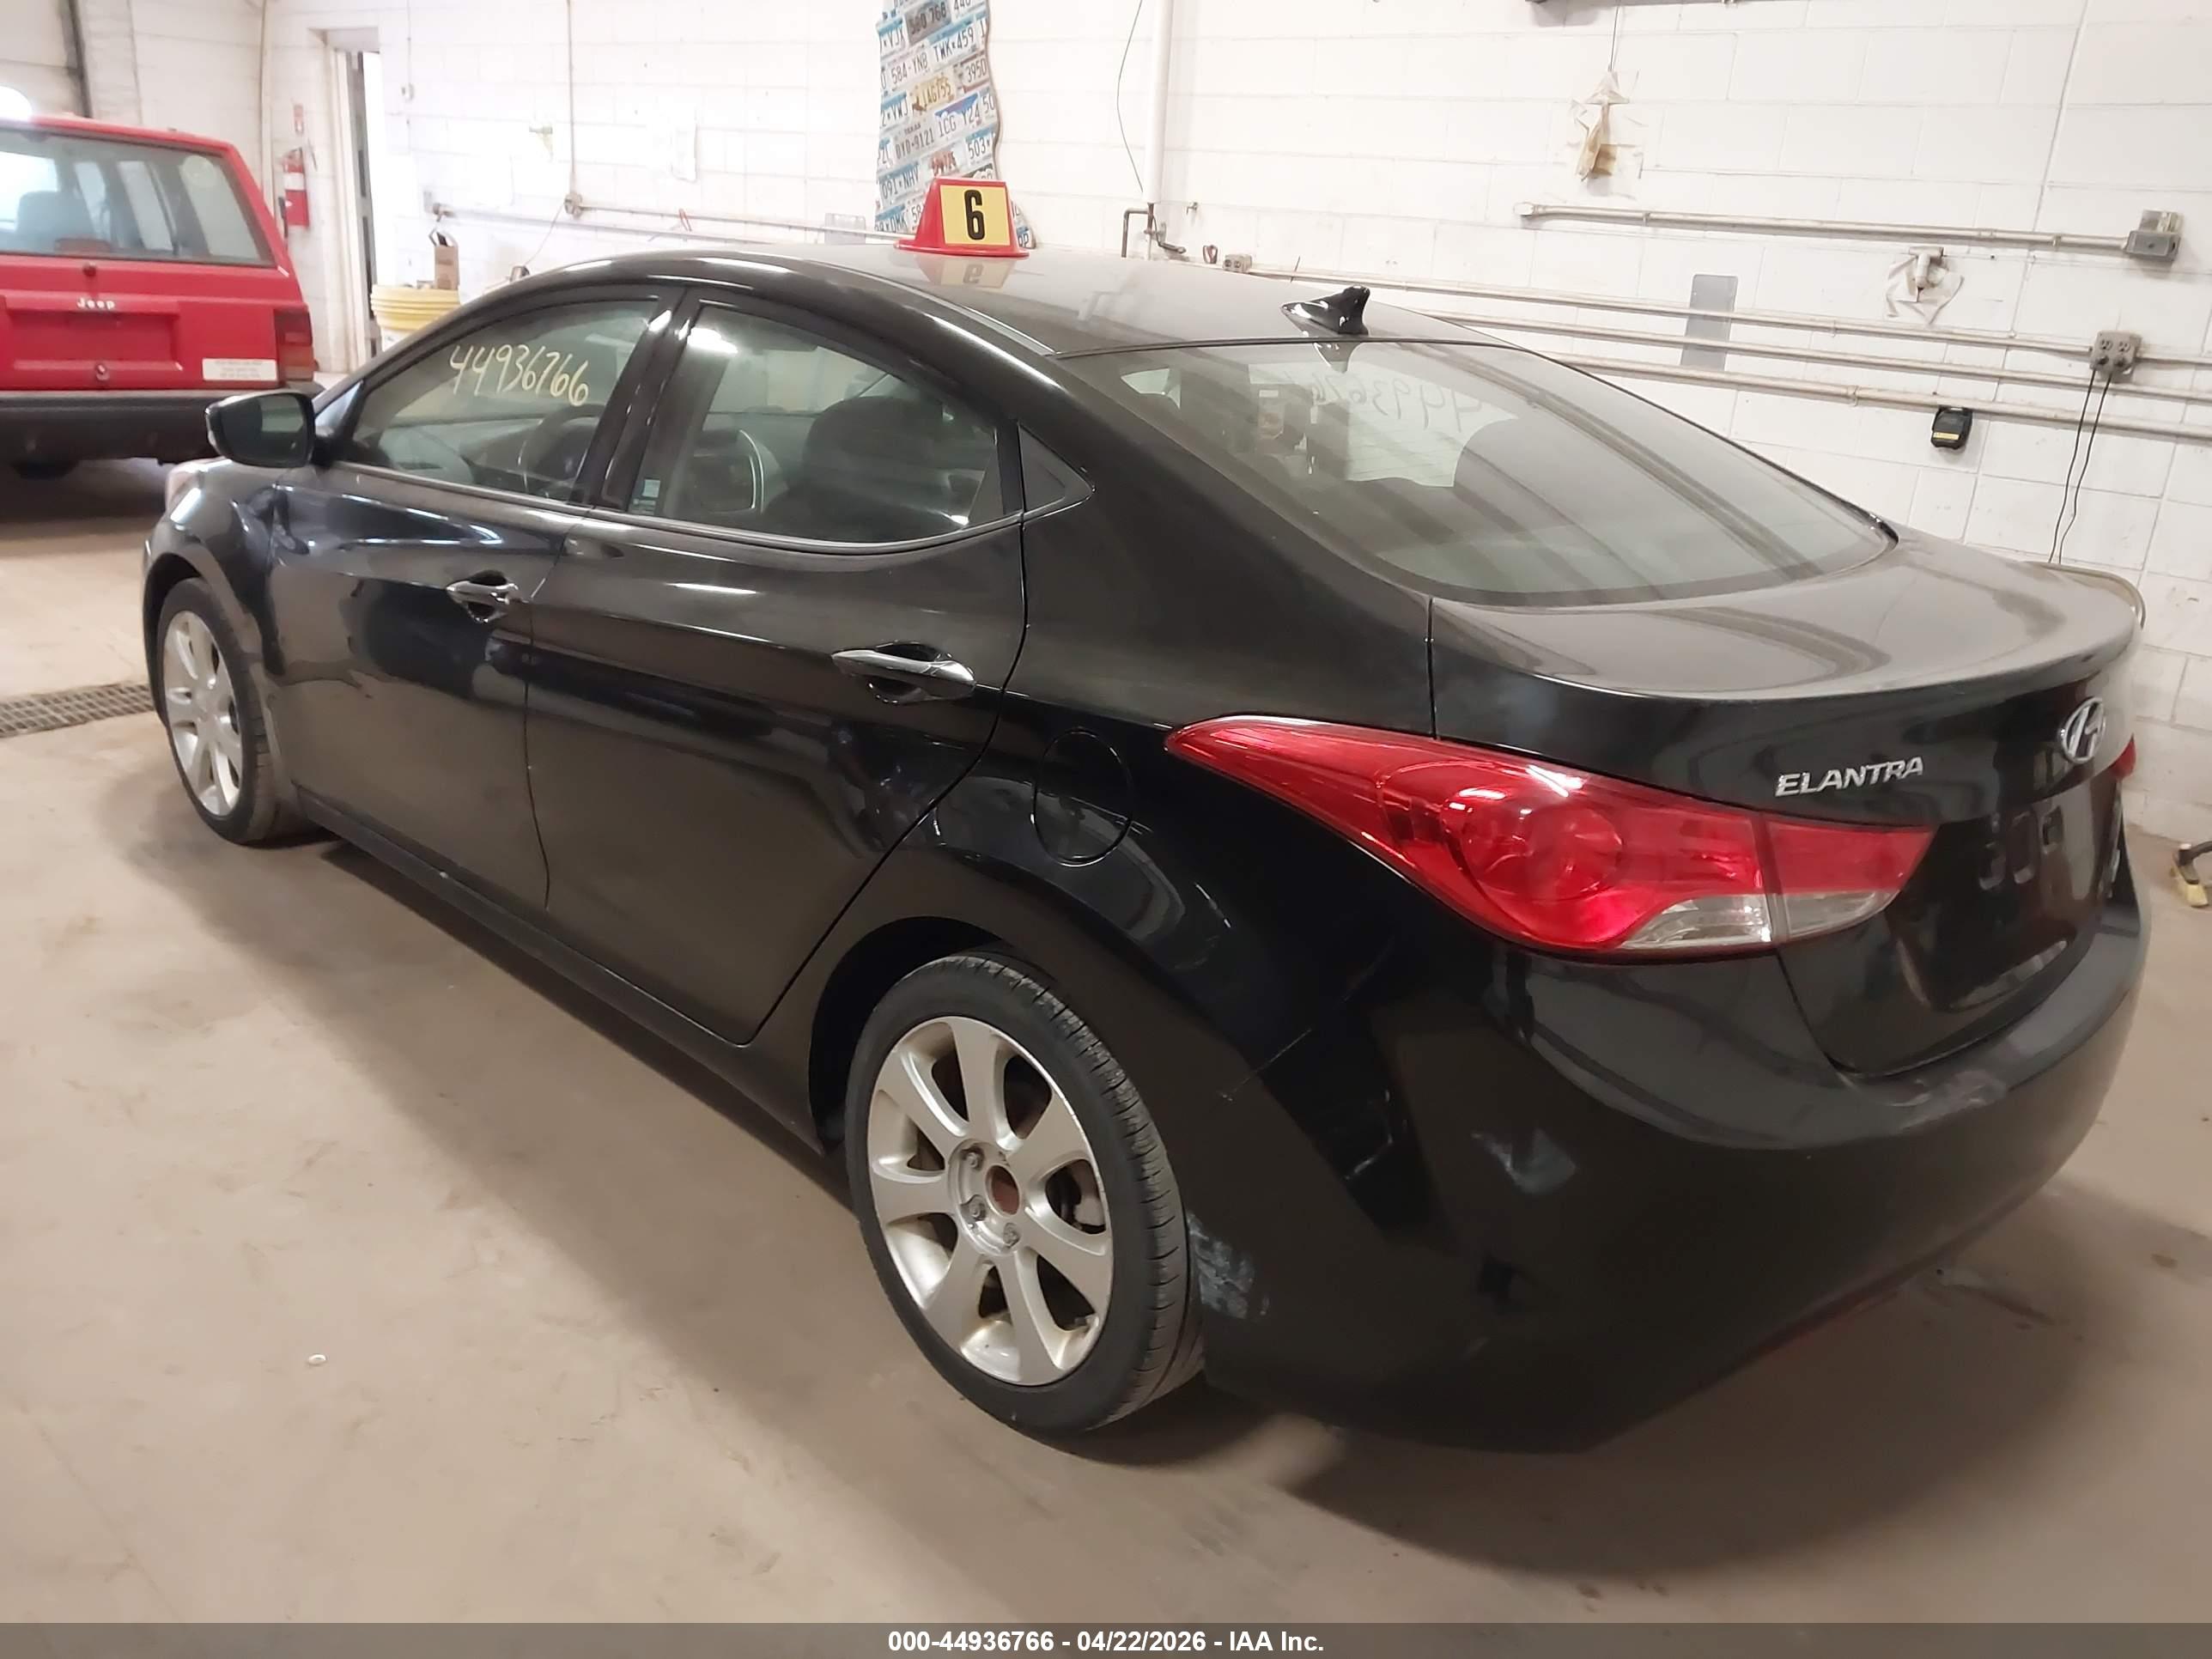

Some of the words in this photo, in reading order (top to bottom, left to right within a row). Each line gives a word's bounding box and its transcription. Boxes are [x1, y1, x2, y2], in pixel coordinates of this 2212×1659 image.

[963, 190, 986, 240] 6
[76, 297, 116, 310] Jeep
[449, 343, 589, 407] 44936766
[1775, 757, 1923, 797] ELANTRA
